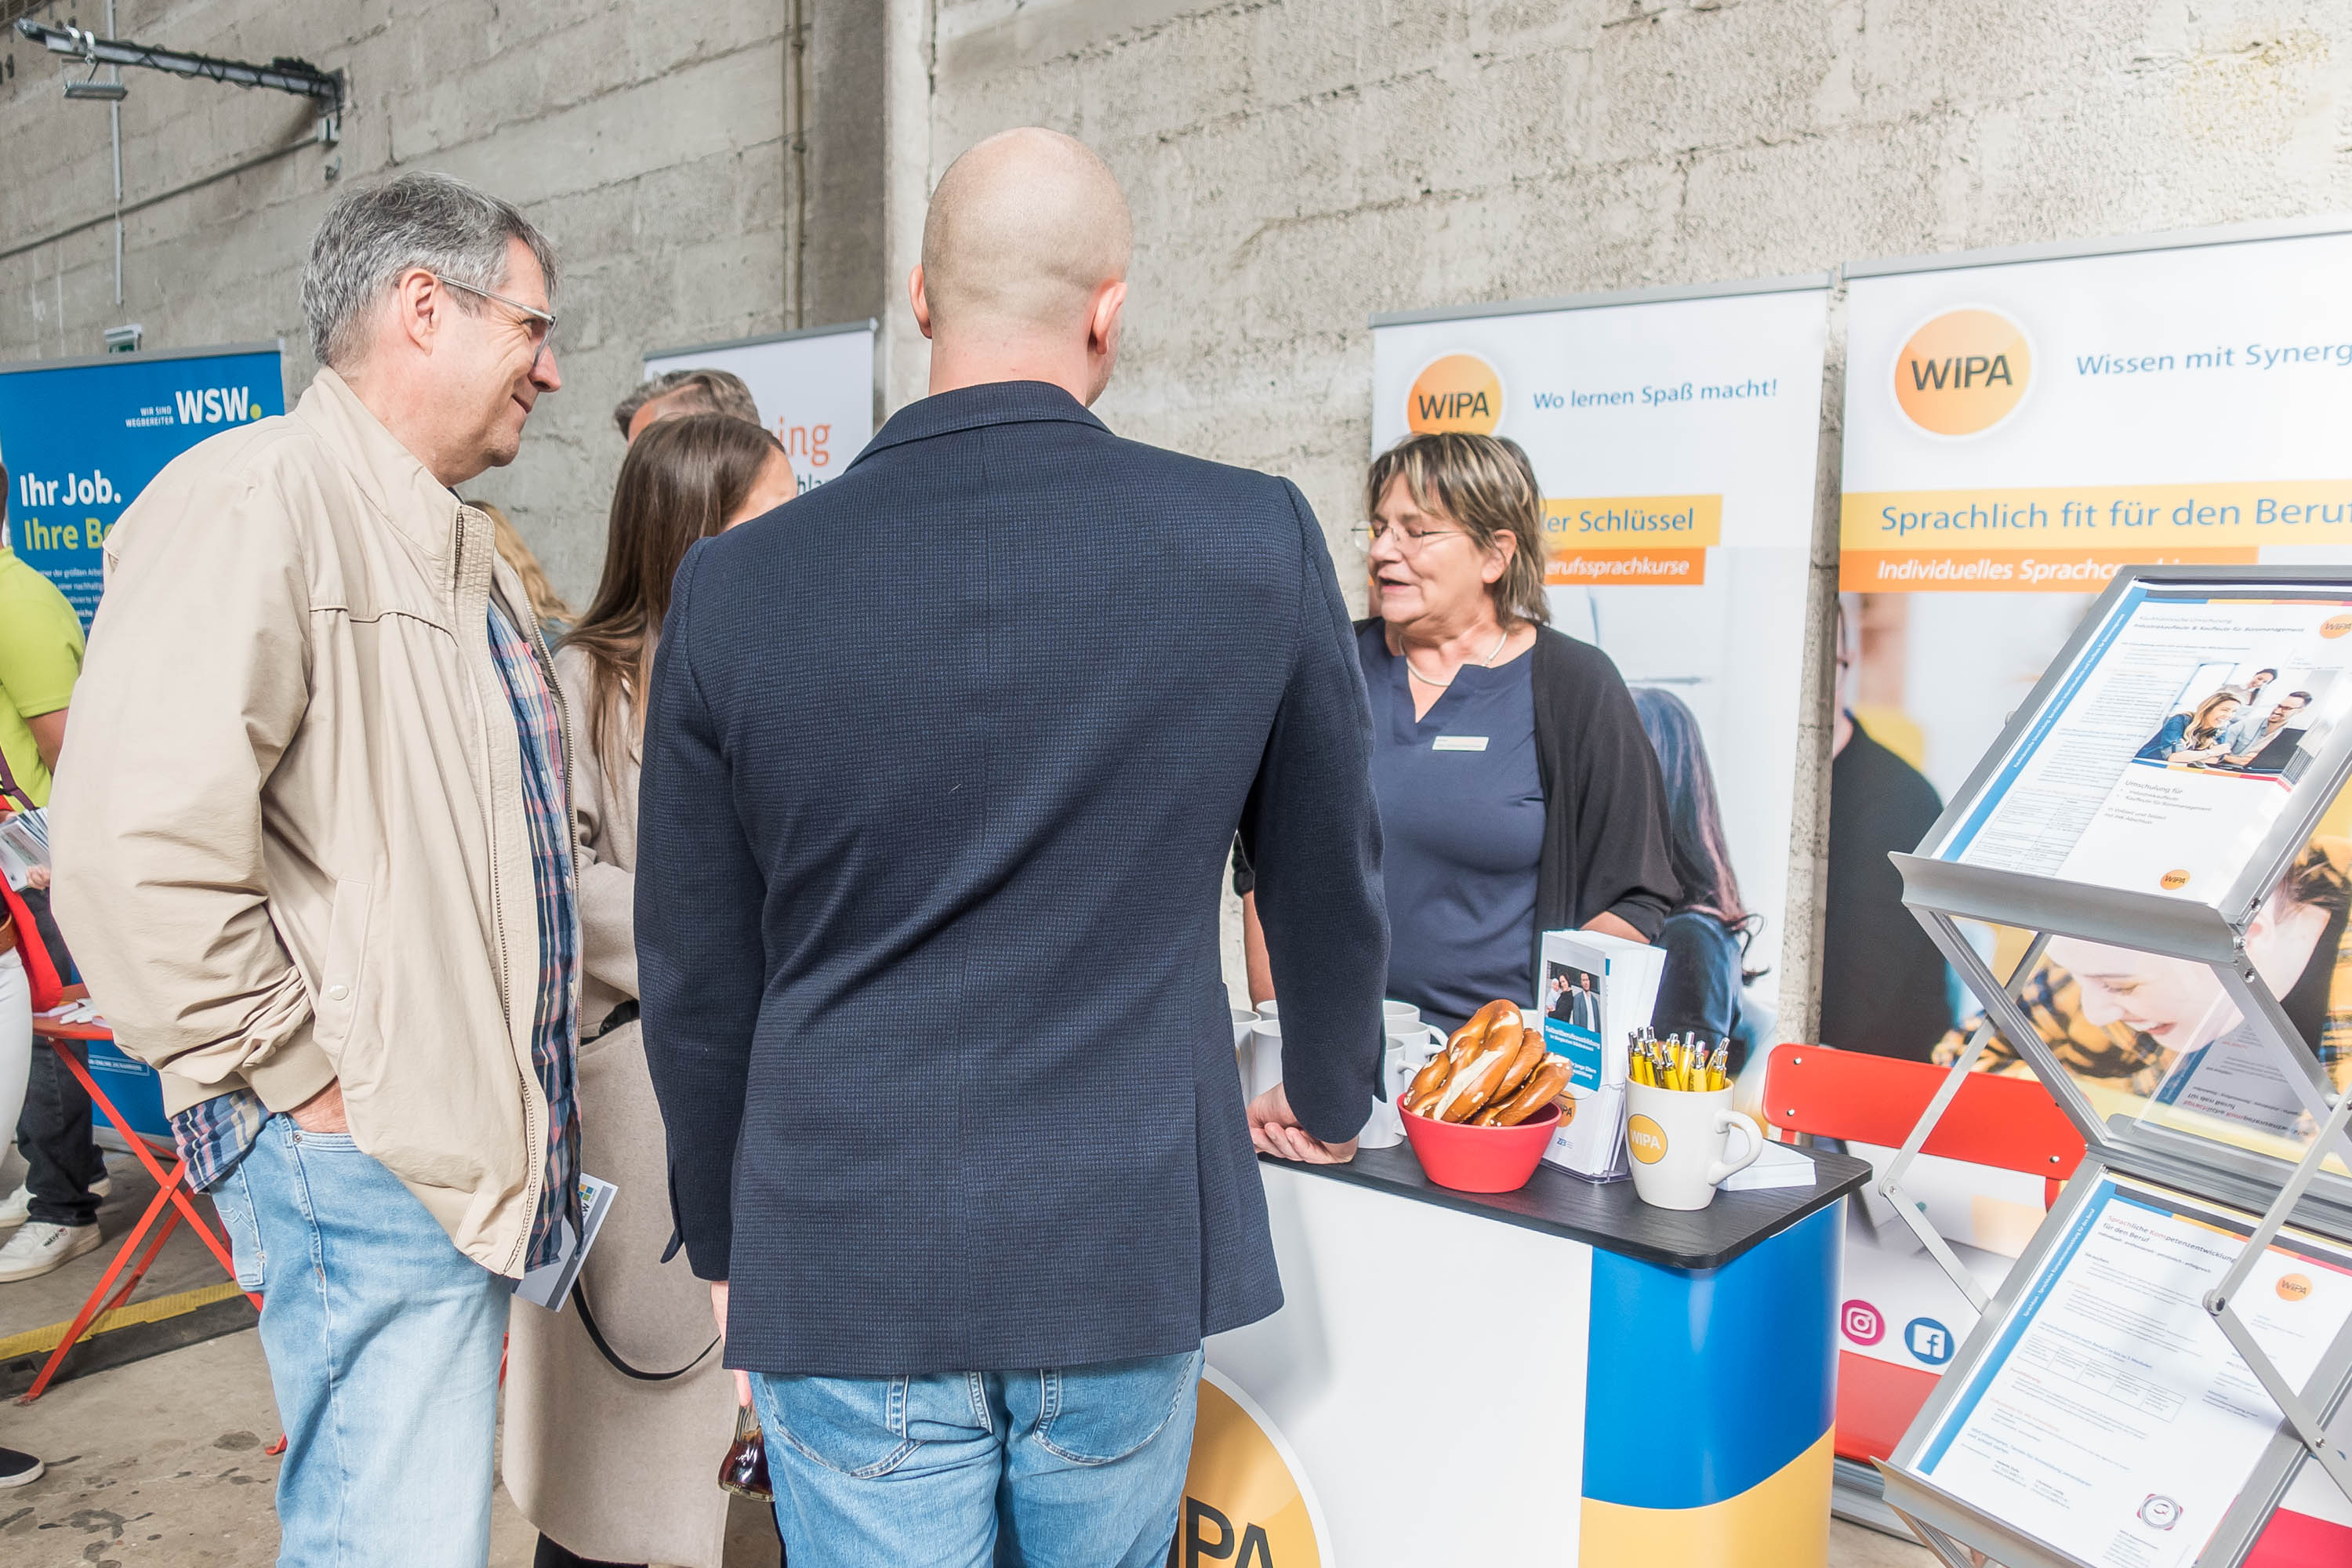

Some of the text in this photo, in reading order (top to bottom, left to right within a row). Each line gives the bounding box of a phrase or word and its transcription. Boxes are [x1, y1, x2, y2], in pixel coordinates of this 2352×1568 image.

[1911, 354, 2014, 391] WIPA
[2077, 354, 2175, 376] Wissen
[2185, 346, 2235, 369] mit
[1418, 392, 1490, 420] WIPA
[1534, 379, 1778, 409] Wo lernen Spaß macht!
[125, 416, 174, 428] WEGBEREITER
[140, 405, 172, 416] WIR SIND
[778, 416, 831, 467] ing
[20, 470, 122, 506] Ihr Job.
[1579, 508, 1694, 532] Schlüssel
[1882, 502, 2049, 536] Sprachlich
[2061, 500, 2099, 528] fit
[2110, 499, 2161, 527] für
[2172, 498, 2241, 526] den
[24, 517, 78, 550] Ihre
[1545, 556, 1690, 579] erufssprachkurse
[1877, 558, 2013, 580] Individuelles
[2164, 875, 2186, 884] WIPA
[1630, 1129, 1661, 1150] WIPA
[2107, 1215, 2149, 1234] Sprachliche
[2281, 1279, 2307, 1295] WIPA
[1163, 1495, 1274, 1568] PA
